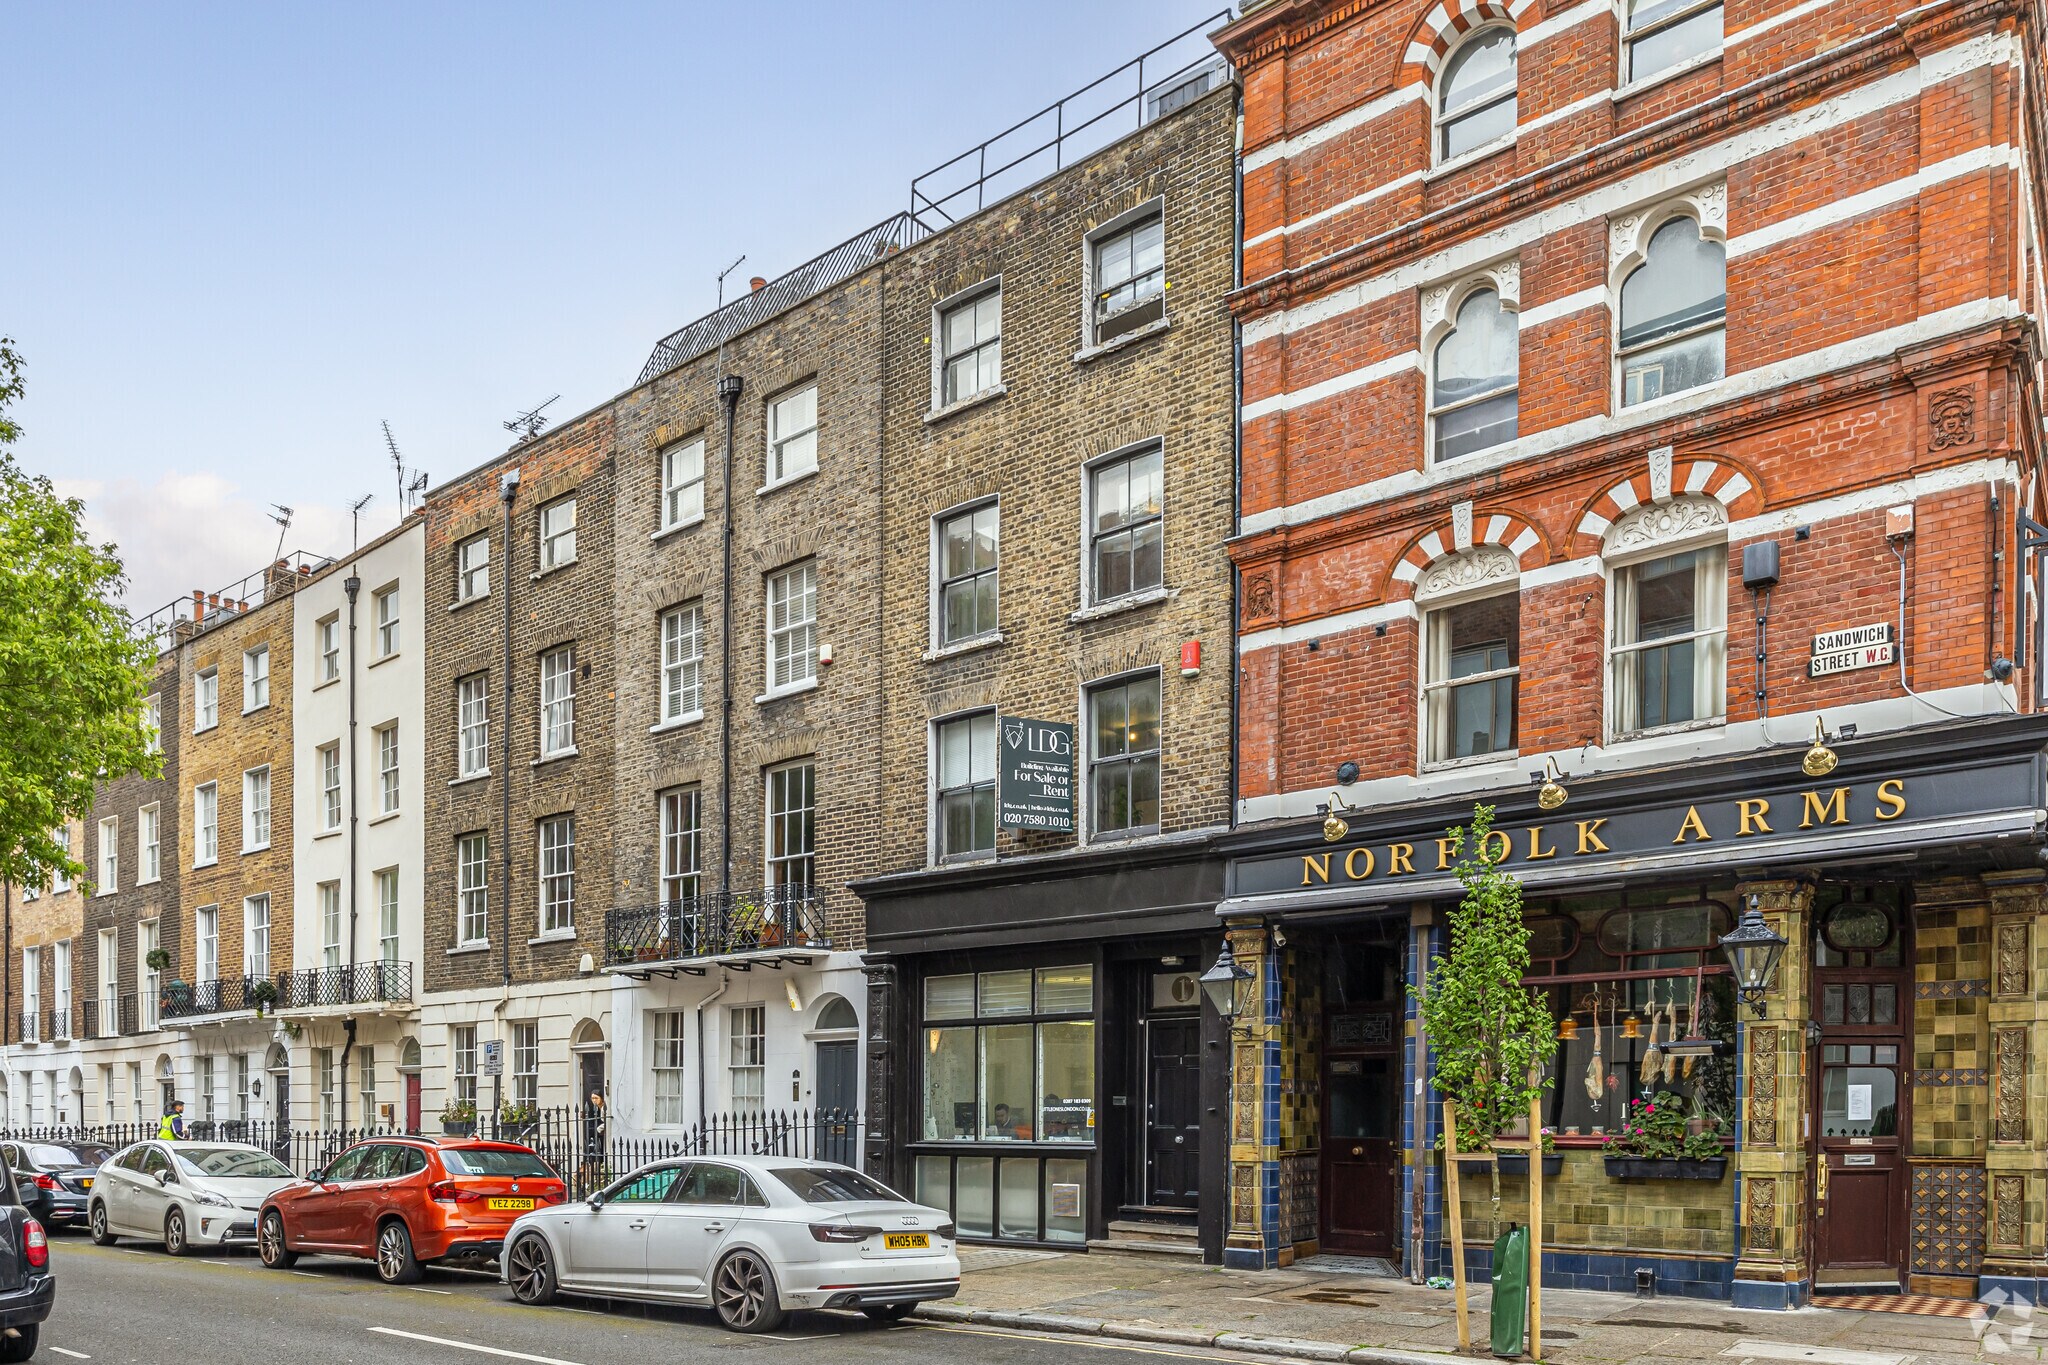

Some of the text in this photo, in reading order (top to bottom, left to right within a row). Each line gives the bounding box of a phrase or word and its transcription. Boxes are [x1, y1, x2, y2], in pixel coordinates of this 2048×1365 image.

[1818, 626, 1884, 651] SANDWICH
[1814, 647, 1890, 673] STREET W.C.
[1028, 727, 1070, 755] LDG
[1020, 762, 1070, 773] Building Available
[1014, 769, 1069, 785] For Sale or
[1043, 784, 1070, 798] Rent
[1003, 812, 1070, 827] 020 7580 1010
[1301, 779, 1907, 886] NORFOLK ARMS
[1178, 978, 1187, 1001] 1
[492, 1199, 531, 1208] YEZ 2298
[911, 1235, 927, 1246] HBK
